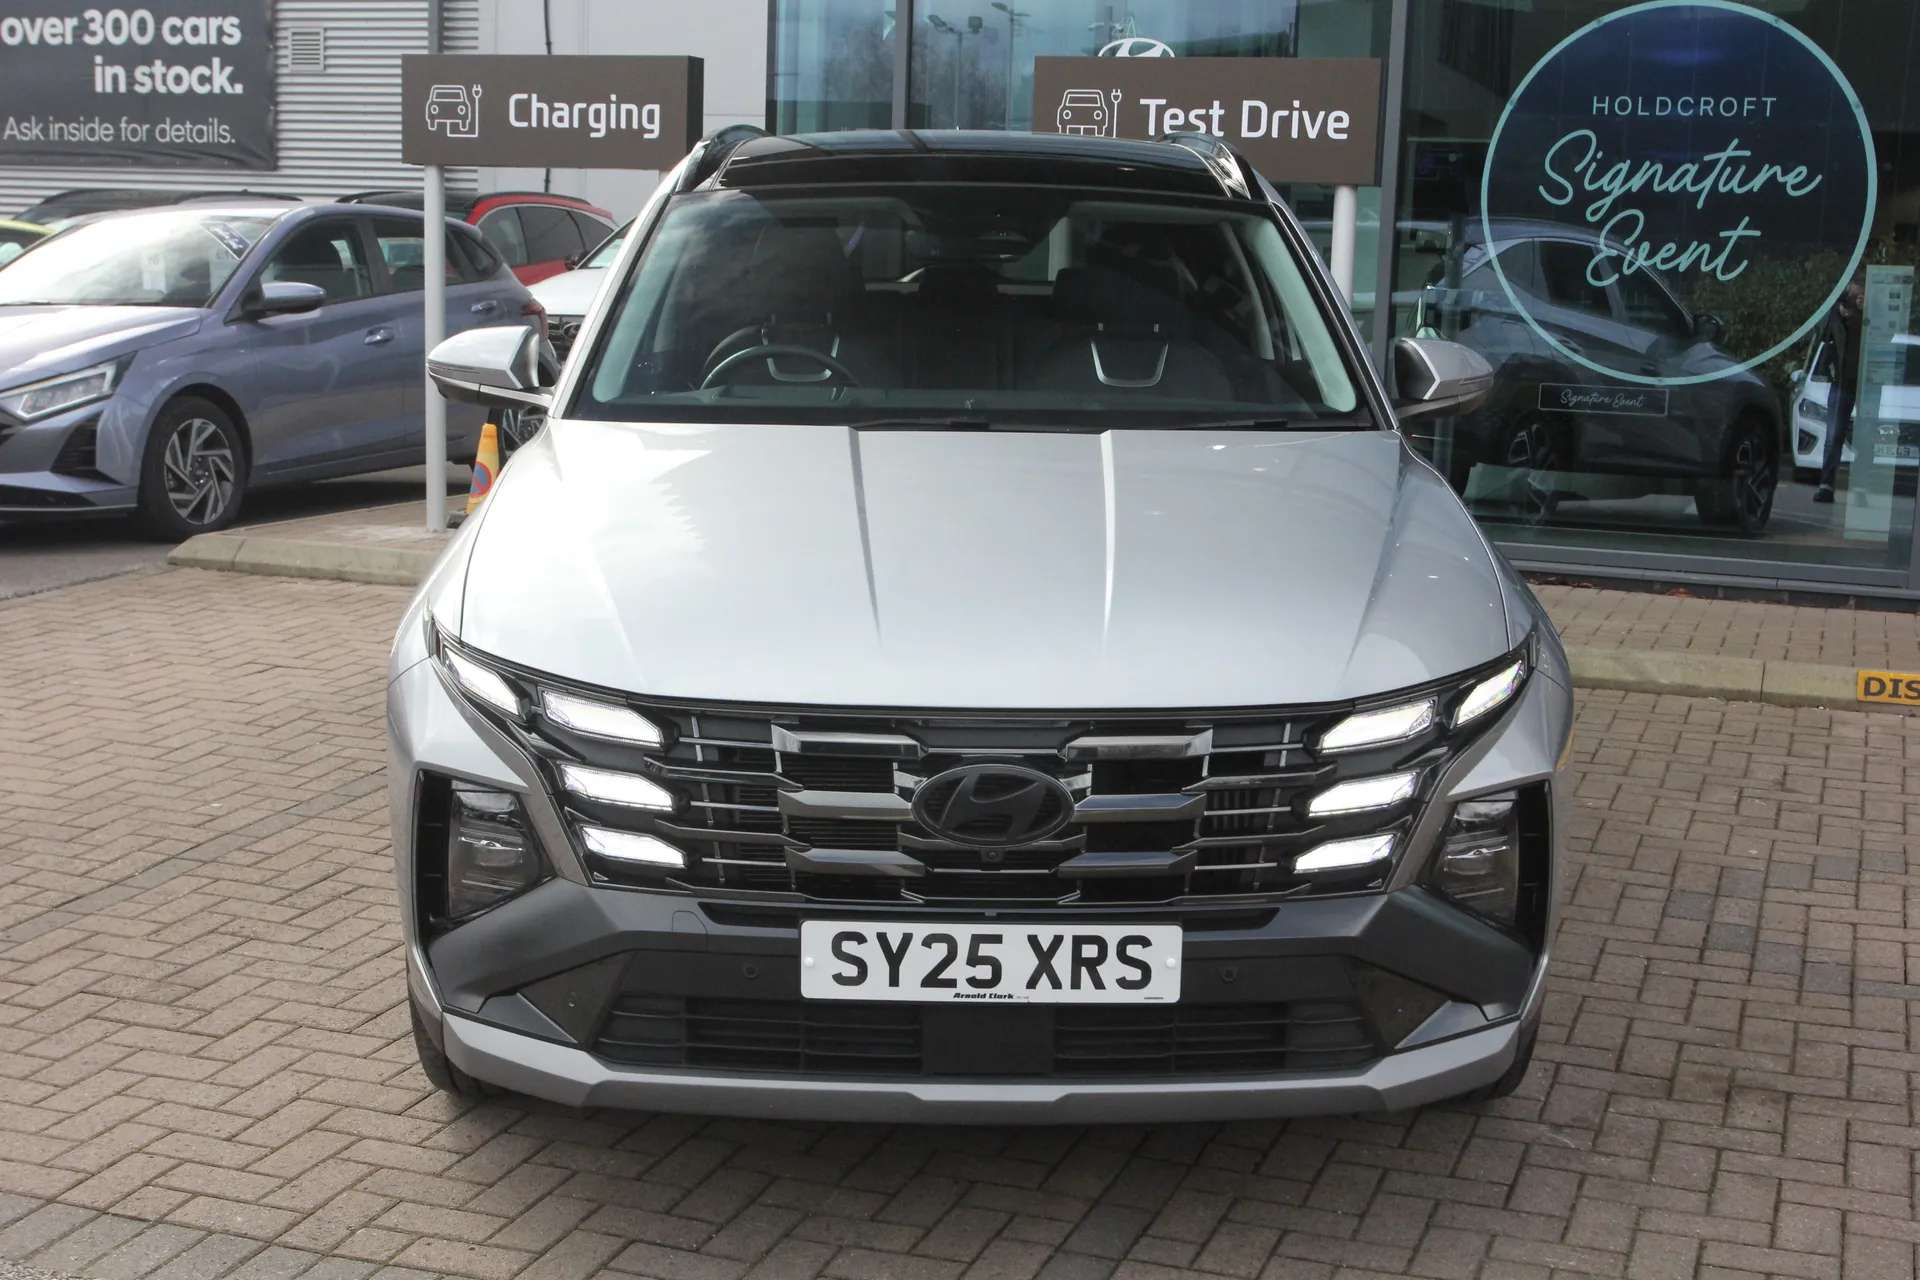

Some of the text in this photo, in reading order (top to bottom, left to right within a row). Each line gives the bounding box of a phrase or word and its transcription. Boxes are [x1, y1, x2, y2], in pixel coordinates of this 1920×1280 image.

[1, 9, 242, 46] over 300 cars
[94, 55, 244, 94] in stock.
[509, 93, 660, 139] Charging
[1139, 98, 1351, 140] Test Drive
[1592, 95, 1777, 117] HOLDCROFT
[3, 116, 236, 144] Ask inside for details.
[1538, 129, 1823, 222] Signature
[1585, 208, 1762, 287] Event
[1560, 388, 1611, 408] Signature
[831, 931, 1153, 991] SY25 XRS
